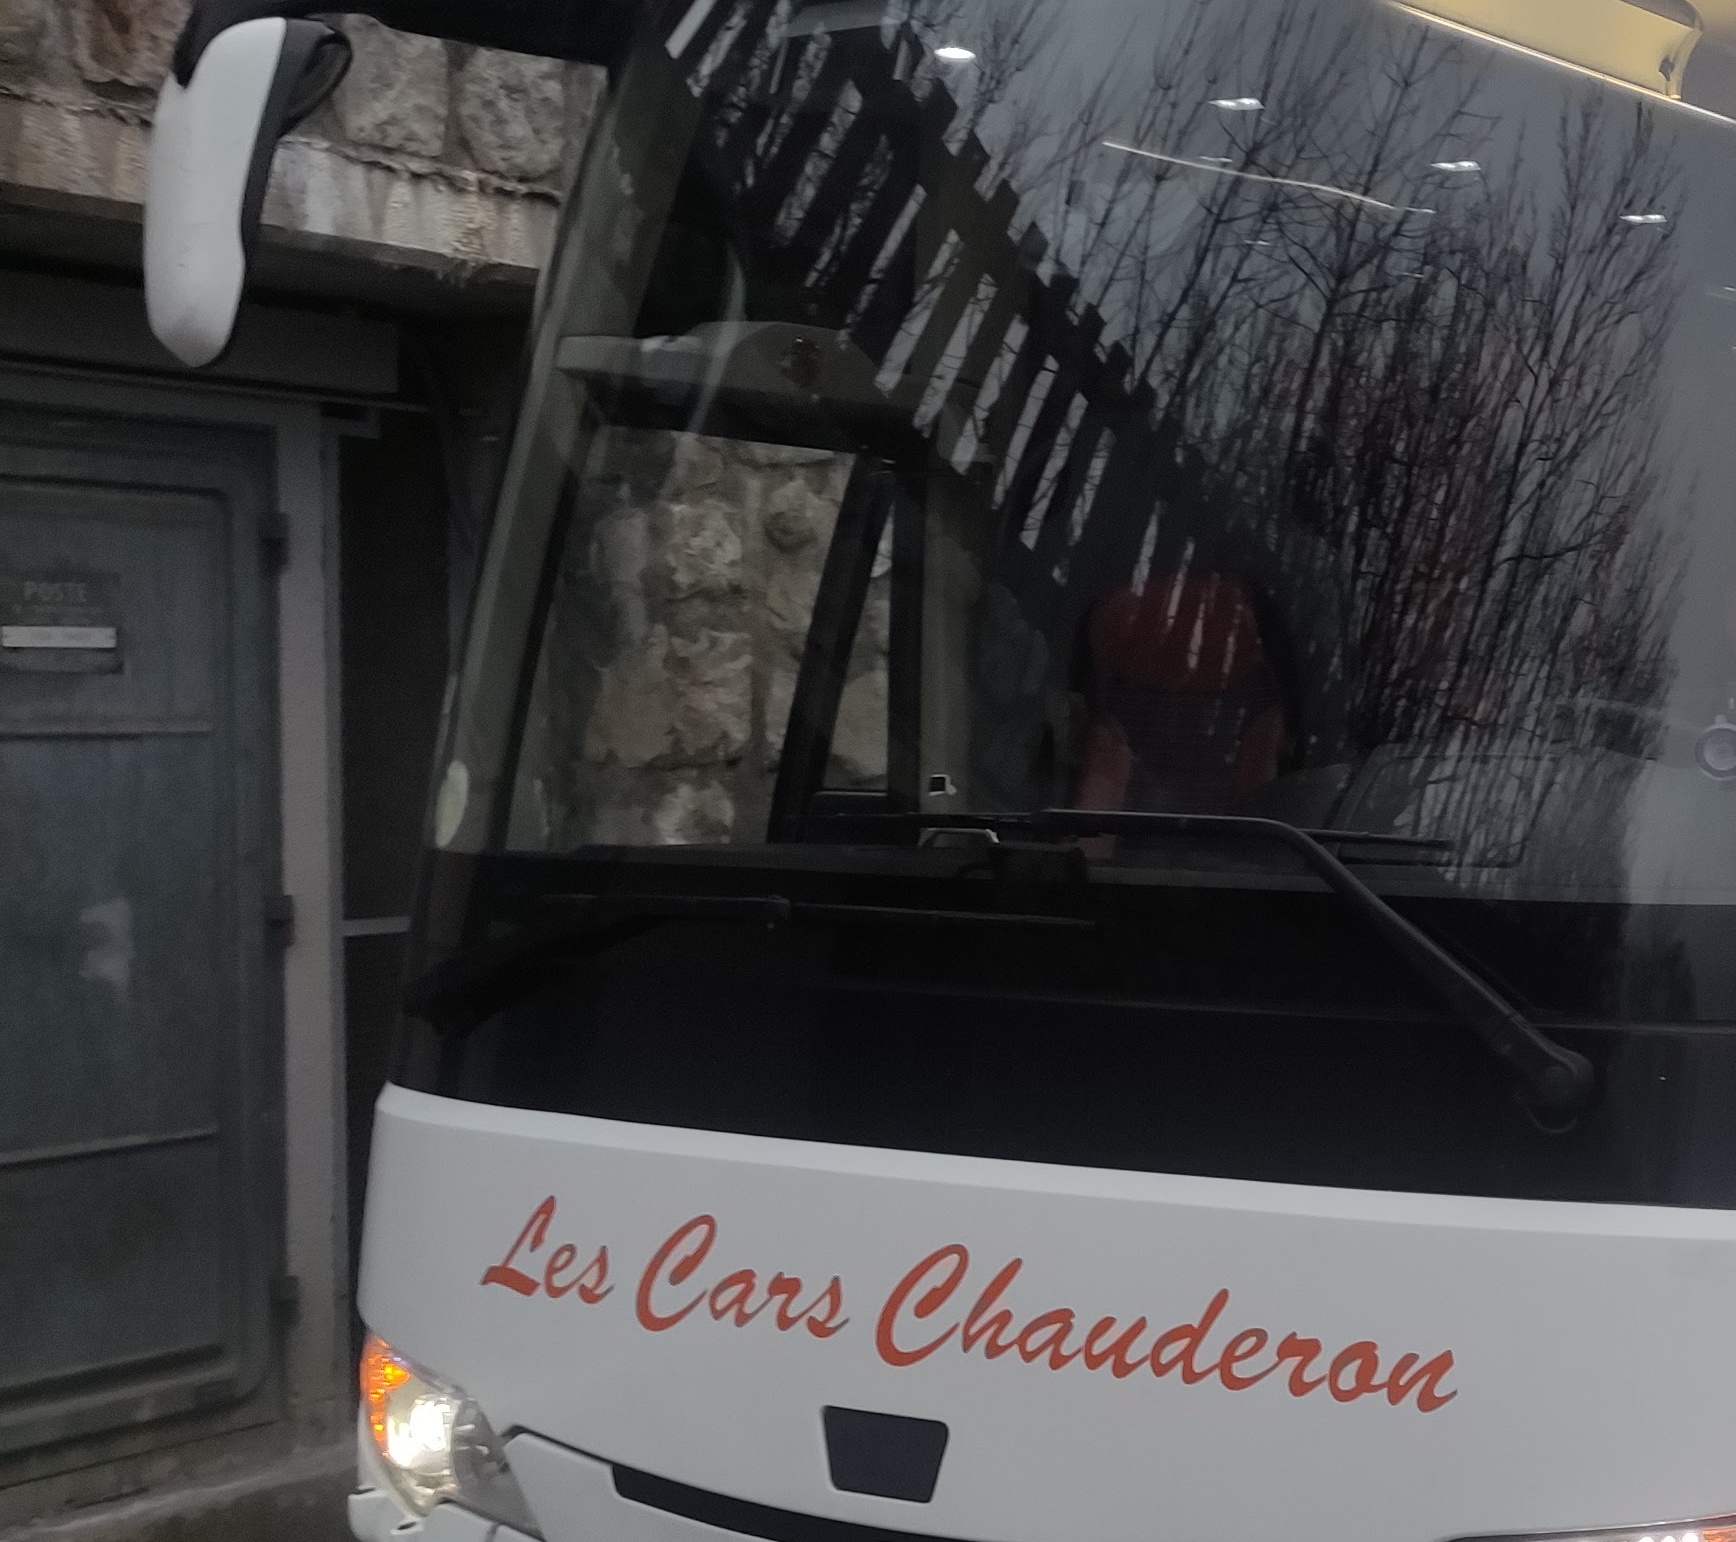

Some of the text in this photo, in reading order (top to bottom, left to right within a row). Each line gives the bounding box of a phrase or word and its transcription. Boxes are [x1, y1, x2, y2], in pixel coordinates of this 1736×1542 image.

[481, 1195, 1458, 1414] Les Cars Chauderon
